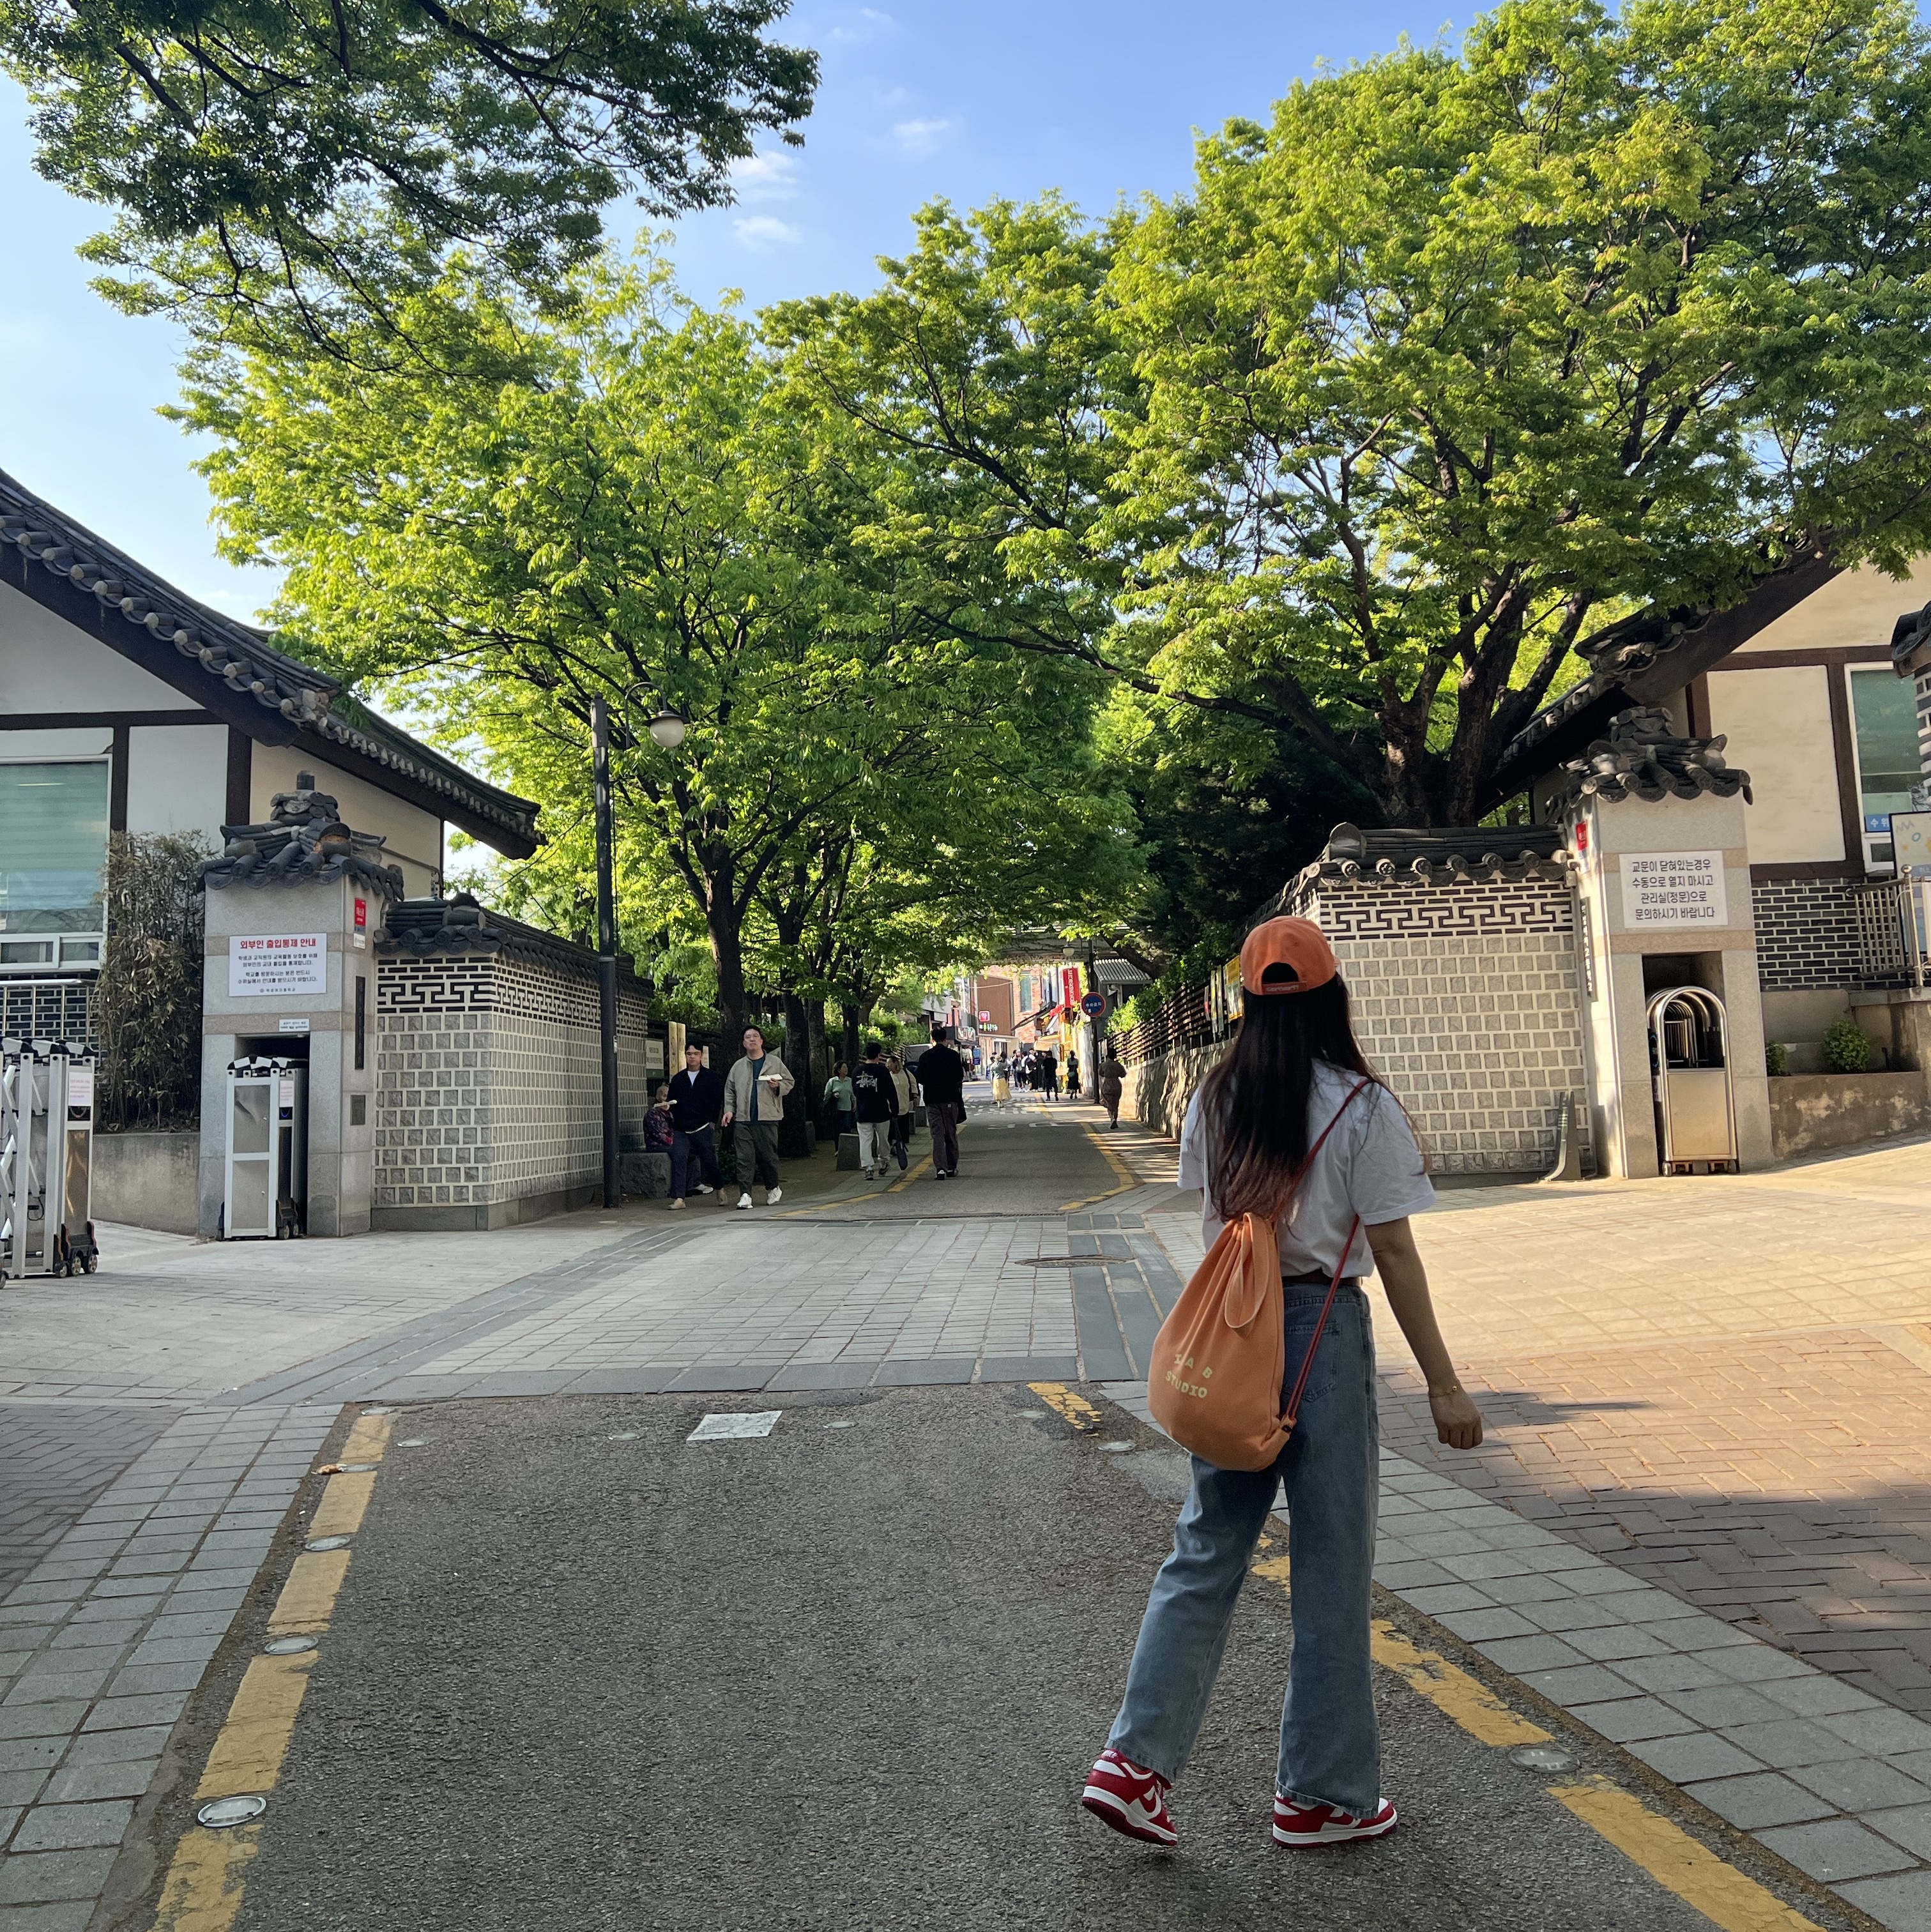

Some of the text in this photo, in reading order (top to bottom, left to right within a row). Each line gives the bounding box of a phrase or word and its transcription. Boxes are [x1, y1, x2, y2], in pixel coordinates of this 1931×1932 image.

[1632, 859, 1711, 872] 교문이 닫혀있는경우
[1632, 875, 1714, 888] 수동으로 열지 마시고
[1640, 891, 1707, 904] 관리실(정문)으로
[1635, 906, 1715, 920] 문의하시기 바랍니다
[240, 938, 316, 949] 외부인 출입통제 안내
[1165, 1371, 1208, 1399] STUDIO
